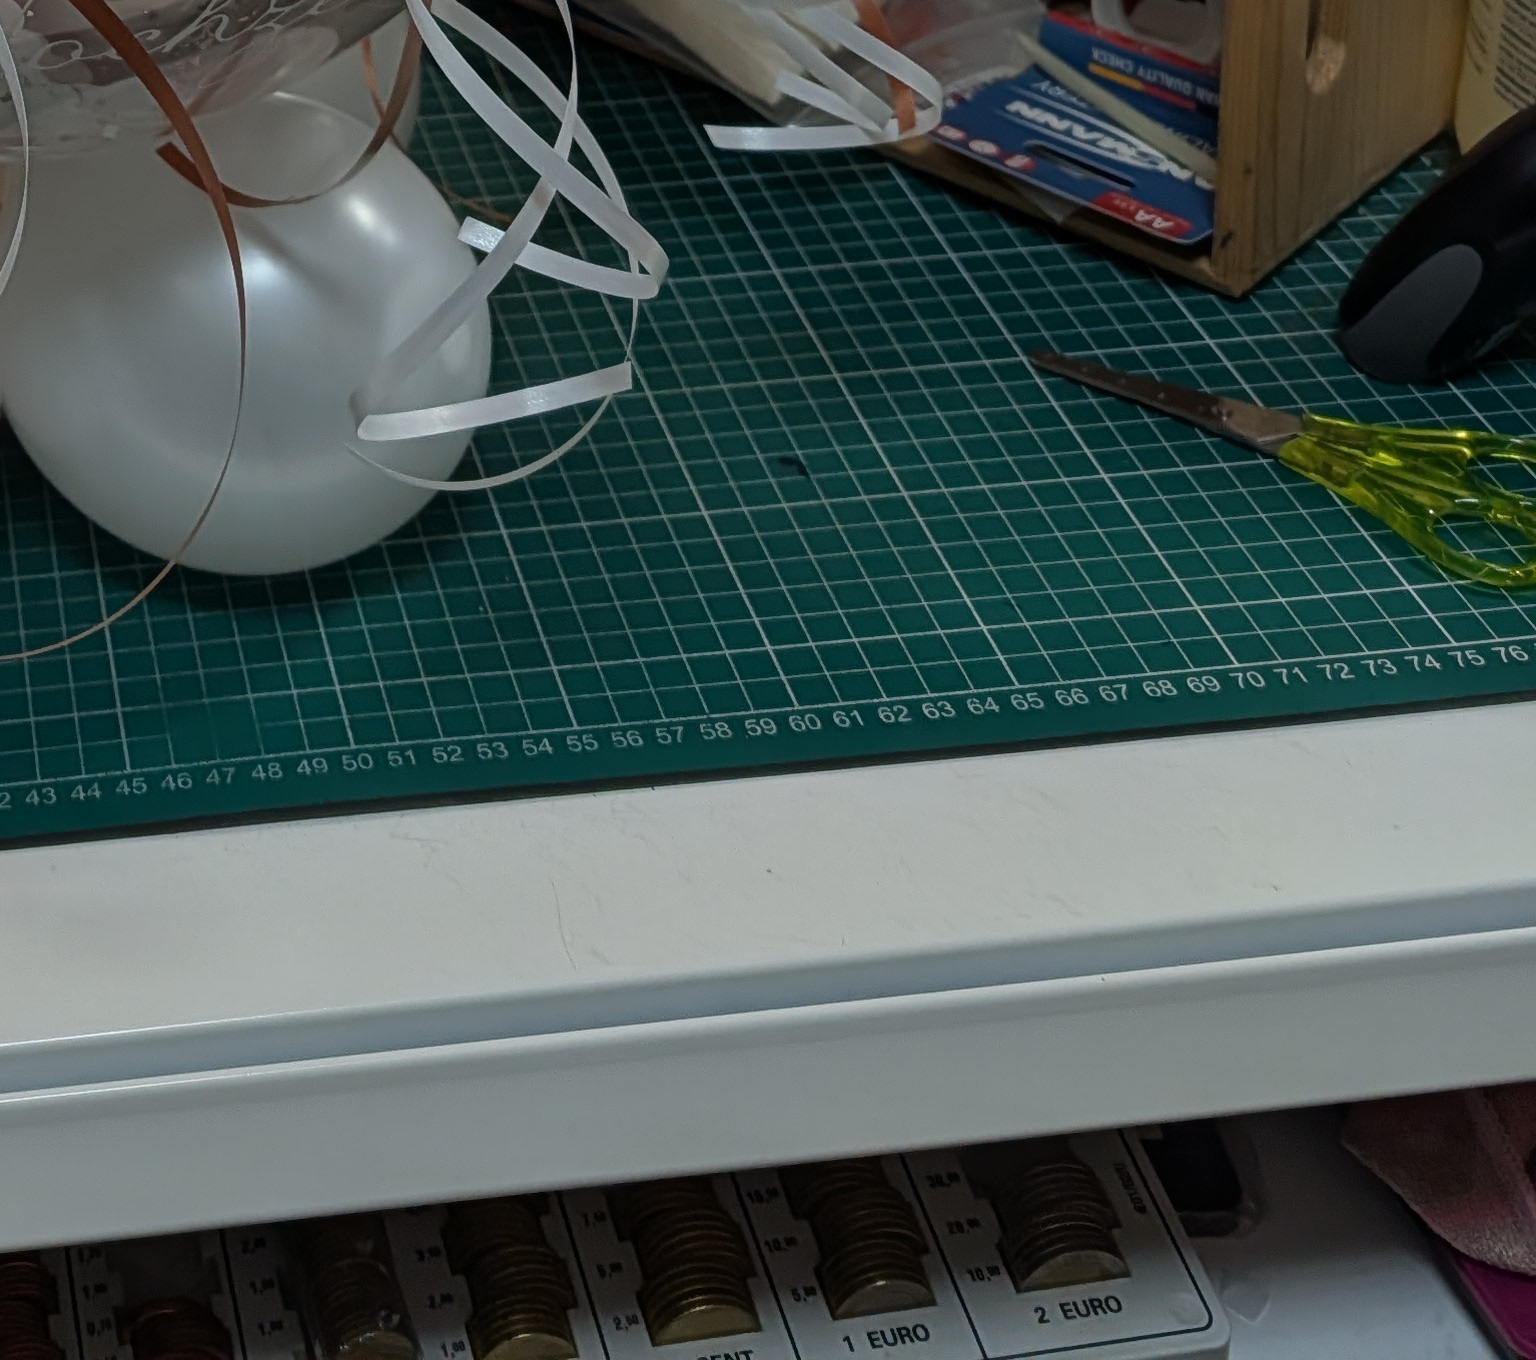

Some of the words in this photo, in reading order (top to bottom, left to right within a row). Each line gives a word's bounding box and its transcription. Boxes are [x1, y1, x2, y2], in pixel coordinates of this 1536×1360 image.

[1090, 46, 1135, 77] CHECK
[1134, 209, 1175, 229] AA
[24, 786, 58, 807] 43
[70, 781, 103, 802] 44
[115, 776, 148, 796] 45
[160, 771, 193, 792] 46
[205, 766, 237, 786] 47
[250, 761, 284, 781] 48
[296, 757, 329, 776] 49
[341, 752, 375, 773] 50
[386, 748, 417, 768] 51
[431, 744, 465, 764] 52
[476, 741, 510, 761] 53
[521, 736, 555, 757] 54
[565, 732, 600, 754] 55
[610, 729, 645, 749] 56
[654, 725, 684, 746] 57
[699, 721, 734, 741] 58
[744, 717, 778, 737] 59
[788, 712, 823, 734] 60
[832, 708, 865, 729] 61
[877, 704, 913, 725] 62
[921, 700, 957, 721] 63
[965, 696, 1001, 716] 64
[1009, 691, 1046, 712] 65
[1054, 686, 1091, 707] 66
[1097, 683, 1129, 704] 67
[1141, 679, 1178, 700] 68
[1185, 674, 1222, 695] 69
[1229, 670, 1267, 690] 70
[1273, 666, 1309, 687] 71
[1315, 661, 1356, 682] 72
[1359, 657, 1398, 678] 73
[1402, 653, 1442, 673] 74
[1446, 648, 1486, 669] 75
[1490, 644, 1530, 665] 76
[1033, 1306, 1051, 1325] 2
[1058, 1295, 1123, 1321] EURO
[842, 1335, 855, 1353] 1
[866, 1323, 931, 1351] EURO
